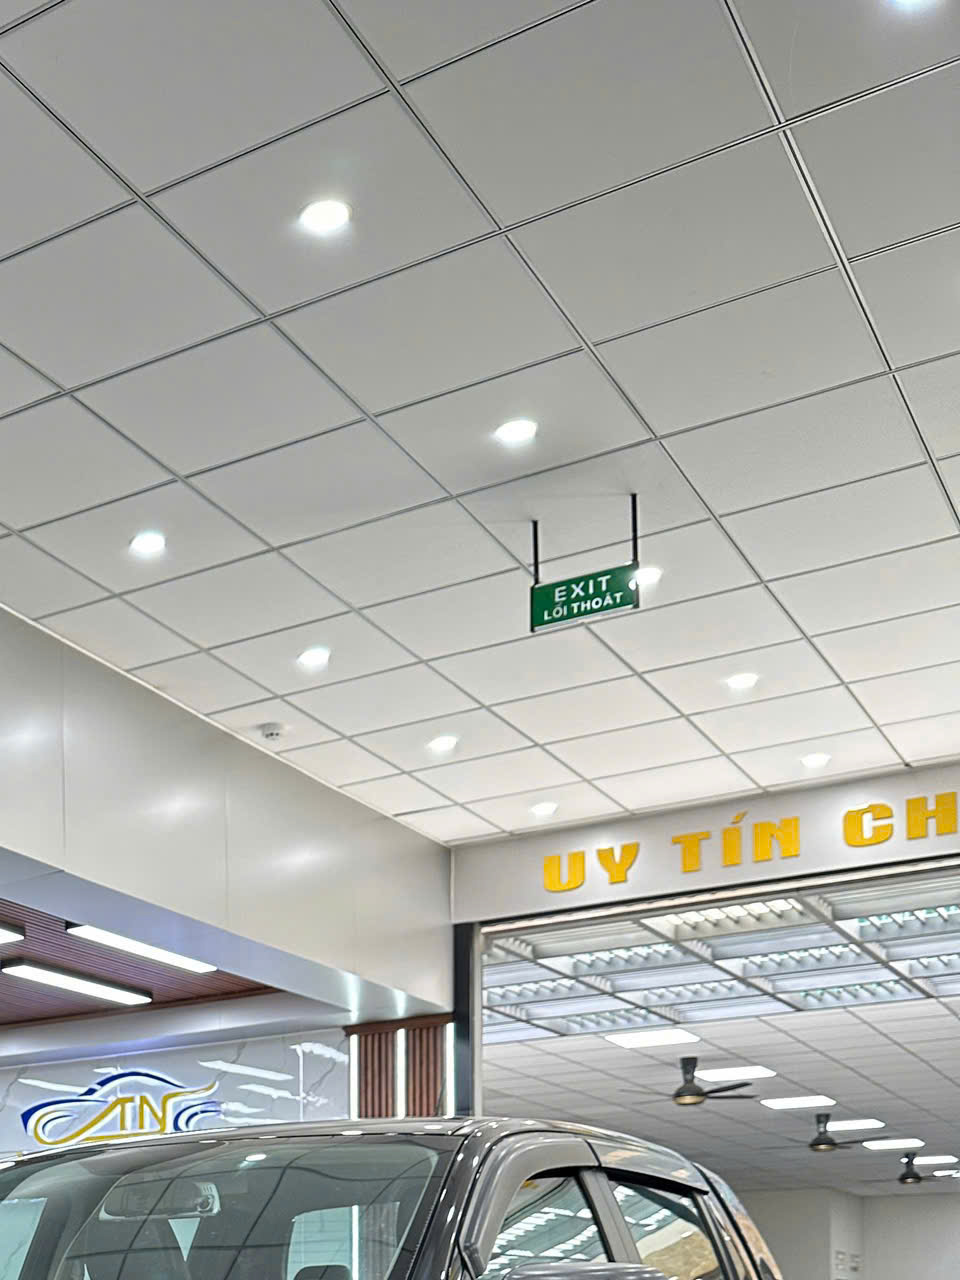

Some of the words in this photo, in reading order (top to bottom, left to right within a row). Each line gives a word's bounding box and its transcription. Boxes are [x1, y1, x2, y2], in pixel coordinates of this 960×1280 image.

[554, 575, 612, 602] EXIT
[571, 592, 623, 614] THOÁT
[543, 842, 640, 892] UY
[671, 810, 801, 873] TÍN
[843, 791, 958, 848] CH
